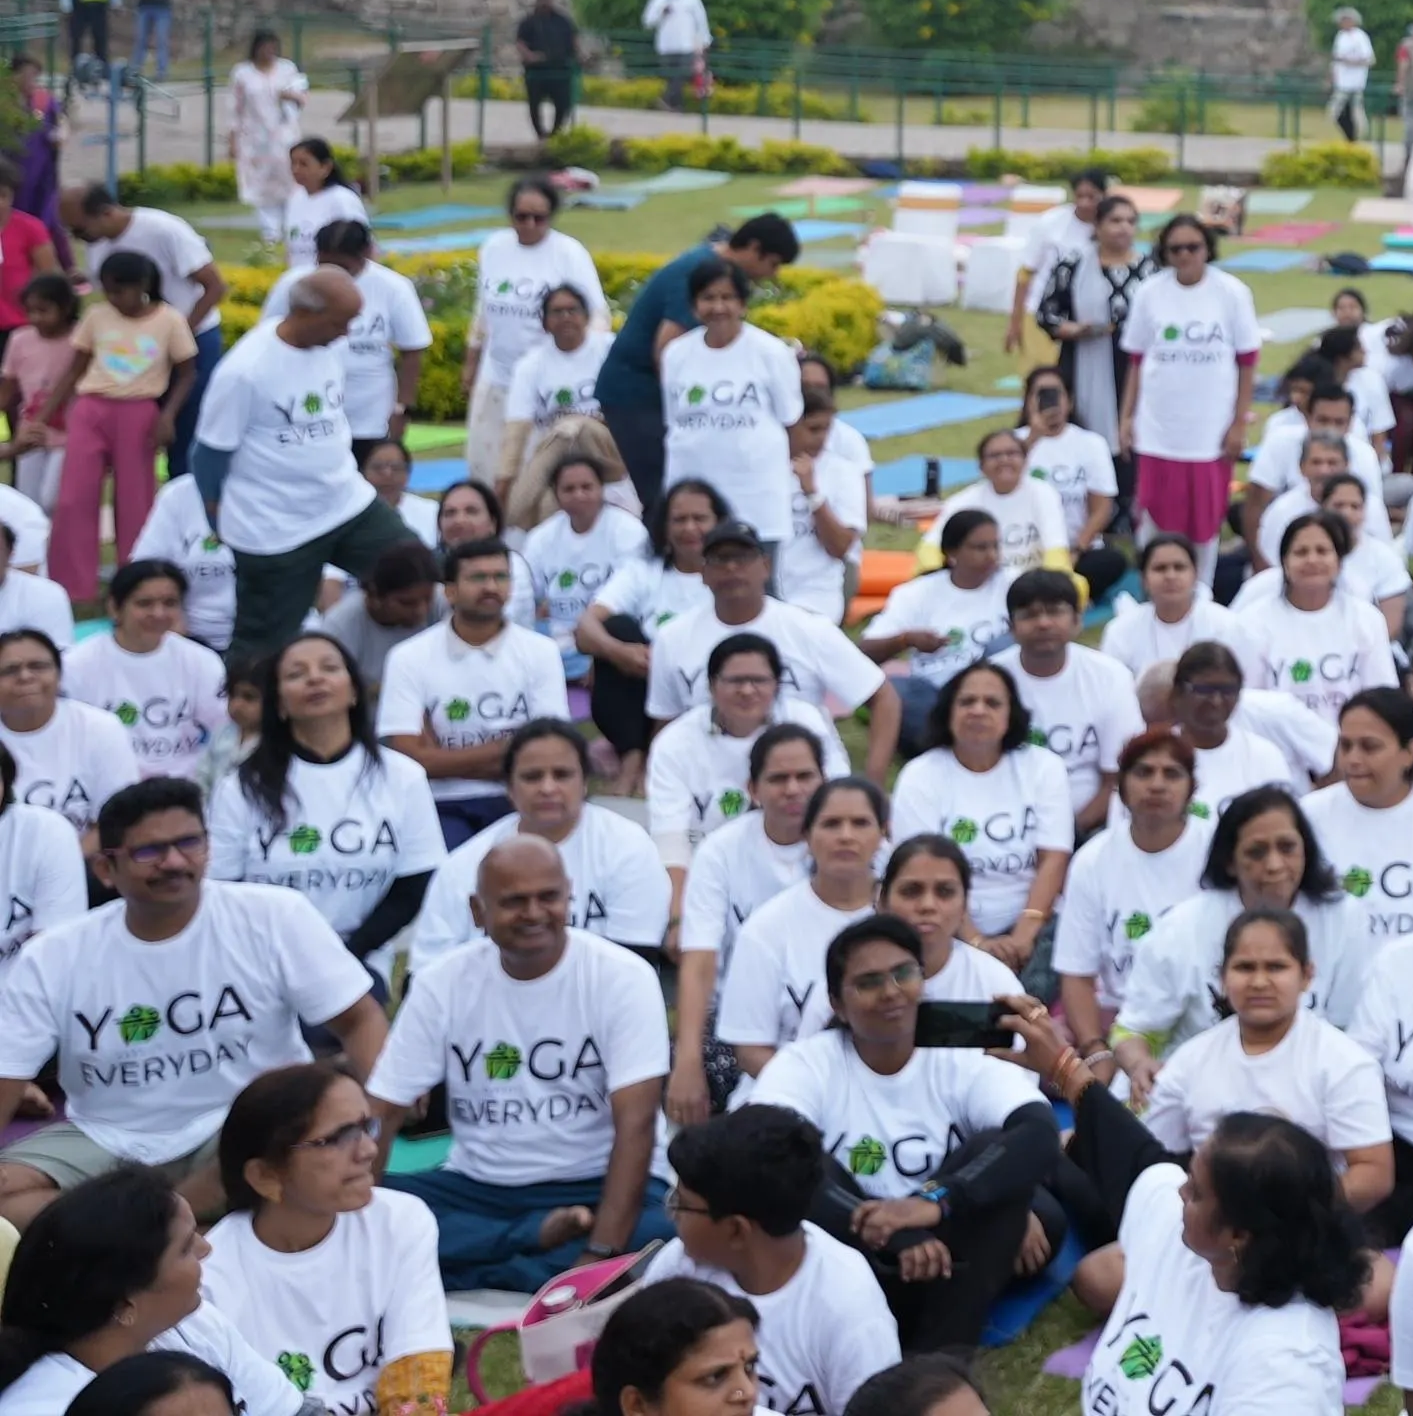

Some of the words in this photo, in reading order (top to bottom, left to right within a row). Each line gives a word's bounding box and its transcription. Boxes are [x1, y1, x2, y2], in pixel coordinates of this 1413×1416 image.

[537, 378, 595, 407] YOG
[1030, 464, 1087, 484] OGA
[256, 817, 398, 861] YOGA
[75, 985, 252, 1051] YOGA
[80, 1038, 251, 1087] EVERYDAY
[451, 1035, 607, 1083] YOGA
[454, 1087, 611, 1125] EVERYDAY
